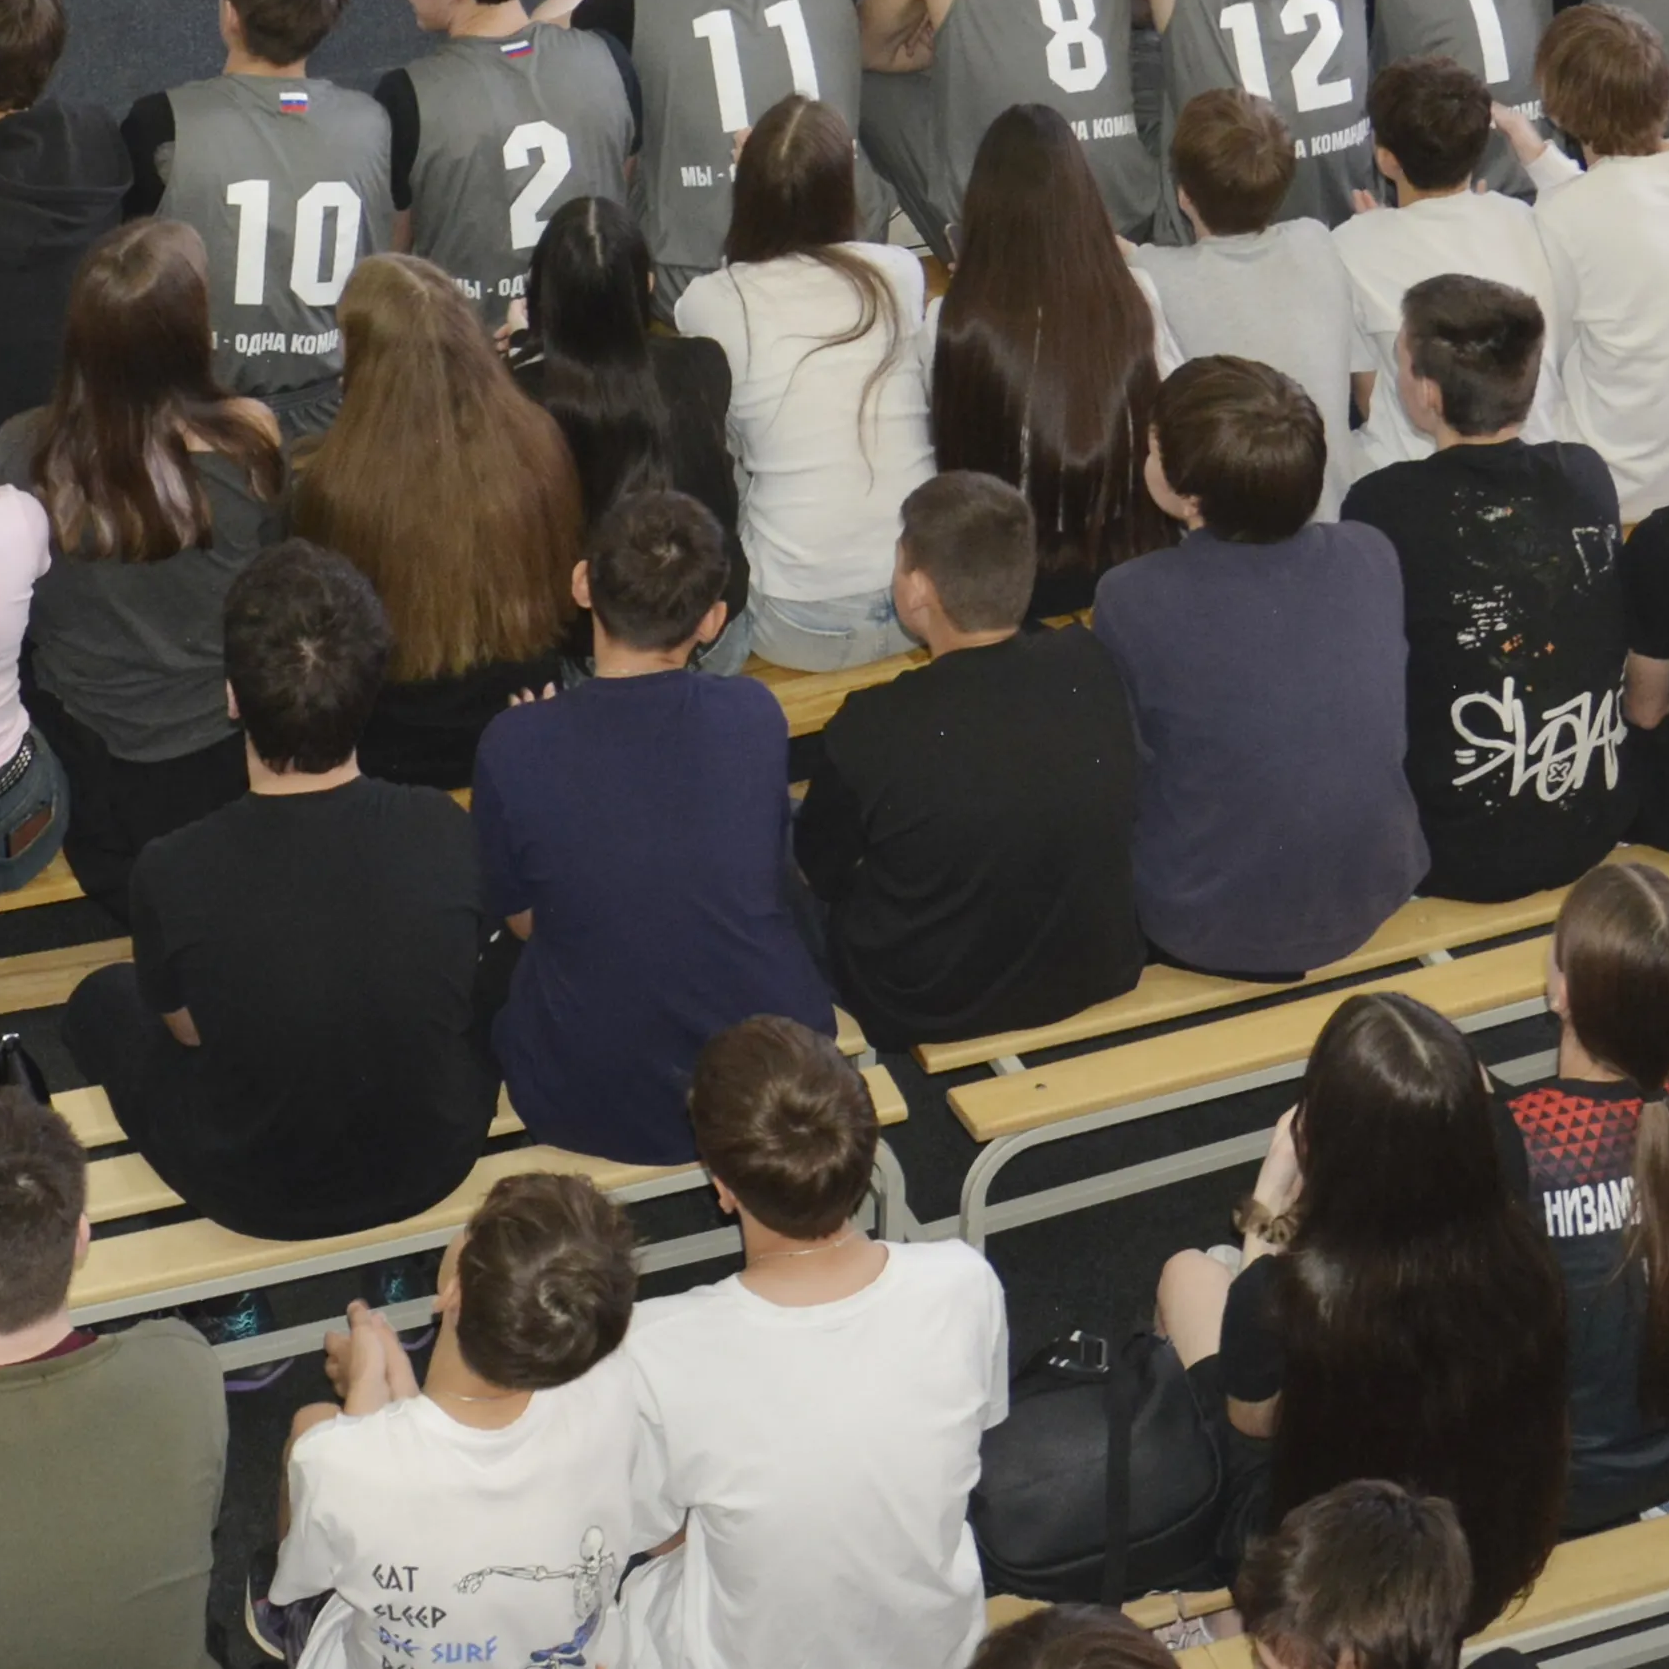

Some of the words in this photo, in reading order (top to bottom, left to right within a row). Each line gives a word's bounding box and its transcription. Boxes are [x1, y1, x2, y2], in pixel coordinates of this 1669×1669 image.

[503, 120, 572, 251] 2
[680, 163, 713, 188] МЫ
[226, 179, 362, 307] 10
[235, 332, 286, 357] ОДНА
[372, 1563, 419, 1593] EAT
[373, 1603, 447, 1629] SLEEP
[431, 1635, 498, 1663] SURF
